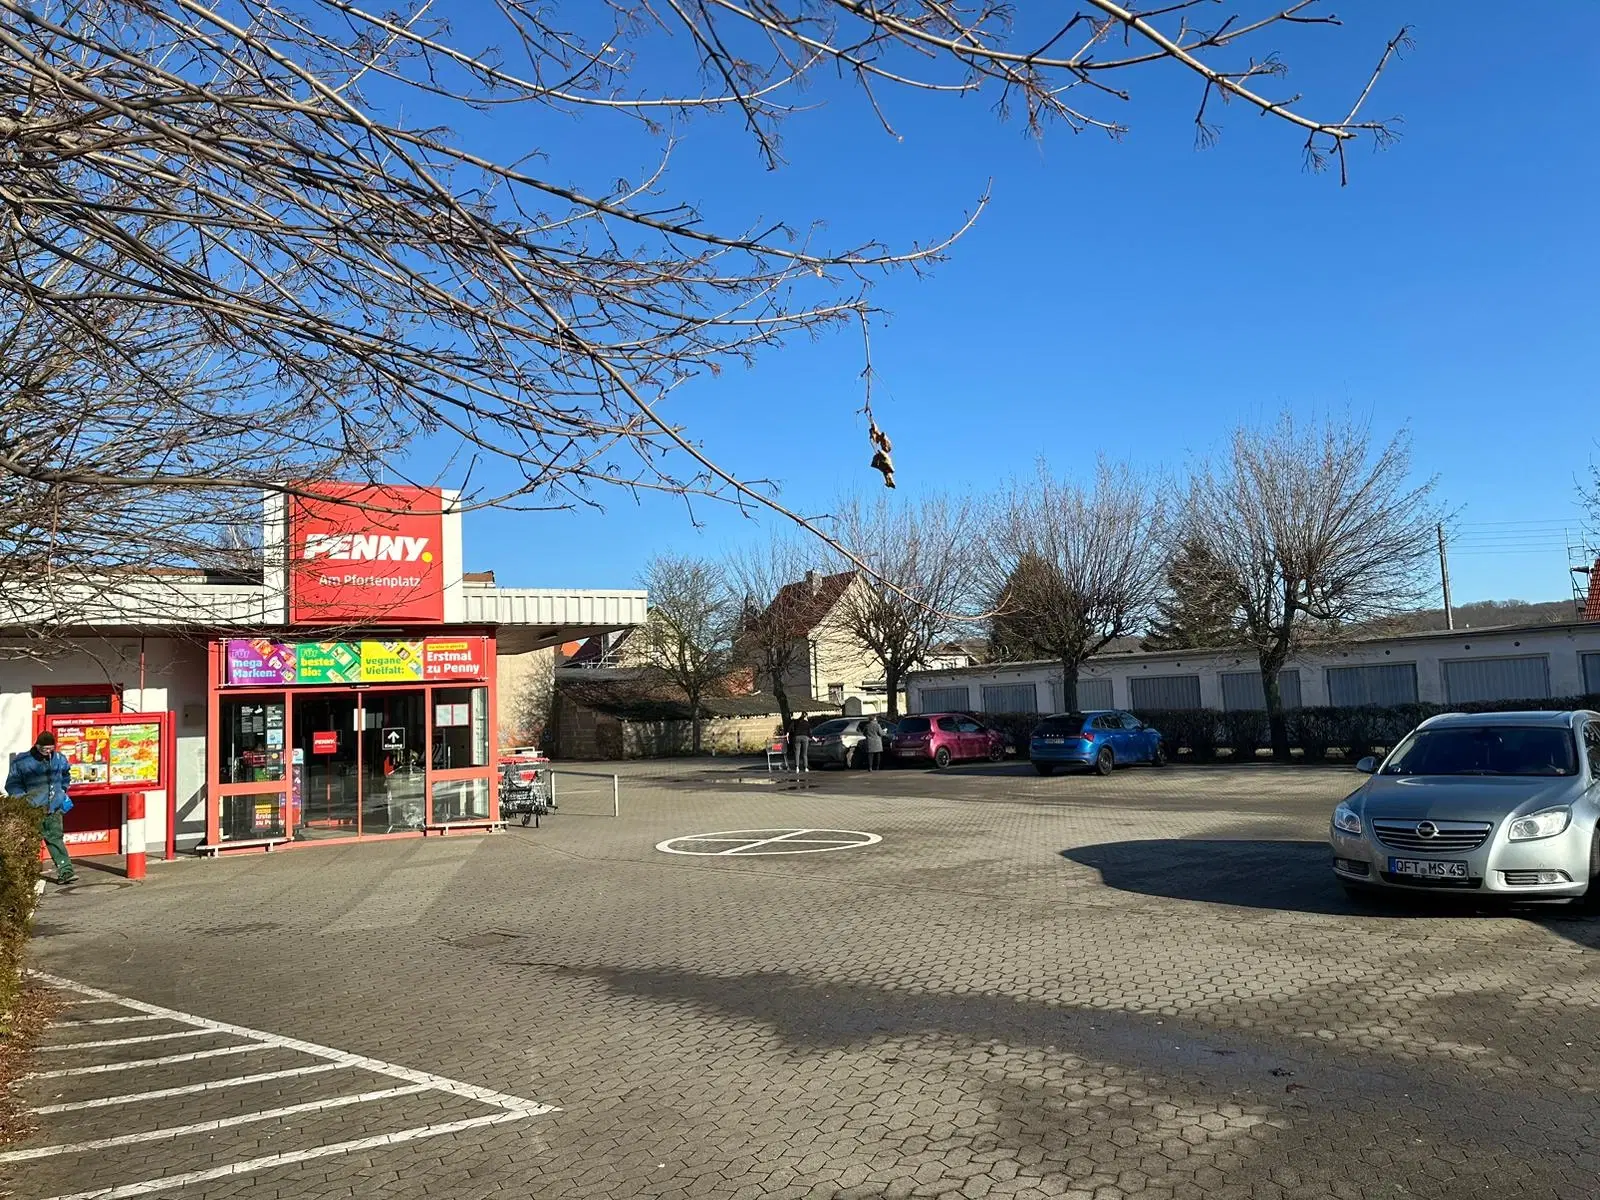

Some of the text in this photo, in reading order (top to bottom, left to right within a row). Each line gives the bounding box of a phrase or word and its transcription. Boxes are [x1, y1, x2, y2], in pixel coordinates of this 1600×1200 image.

[319, 574, 421, 588] Am Pfortenplatz
[427, 650, 472, 662] Erstmal
[232, 659, 263, 669] mega
[301, 657, 335, 667] bestes
[366, 657, 401, 667] vegane
[232, 668, 277, 679] Marken:
[301, 667, 322, 677] Bio:
[366, 666, 405, 675] Vielfalt:
[427, 663, 480, 675] zu Penny
[1396, 860, 1420, 873] QFT
[1428, 862, 1447, 875] MS
[1449, 863, 1466, 876] 45
